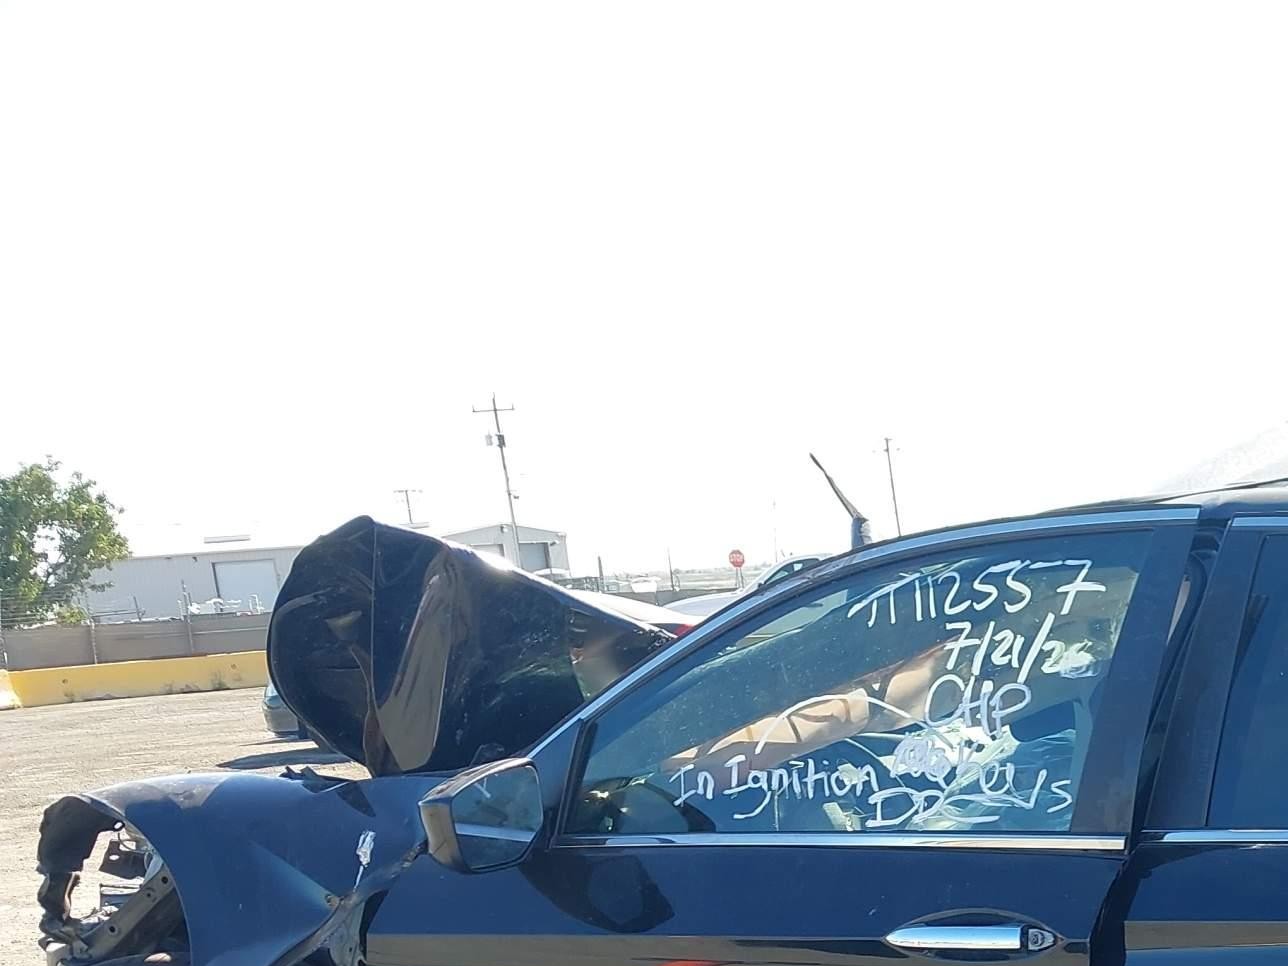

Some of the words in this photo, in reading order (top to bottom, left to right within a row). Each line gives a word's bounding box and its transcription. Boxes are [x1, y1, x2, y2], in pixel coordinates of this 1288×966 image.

[924, 674, 1032, 738] CHP
[669, 764, 715, 807] In
[723, 755, 879, 820] Ignition
